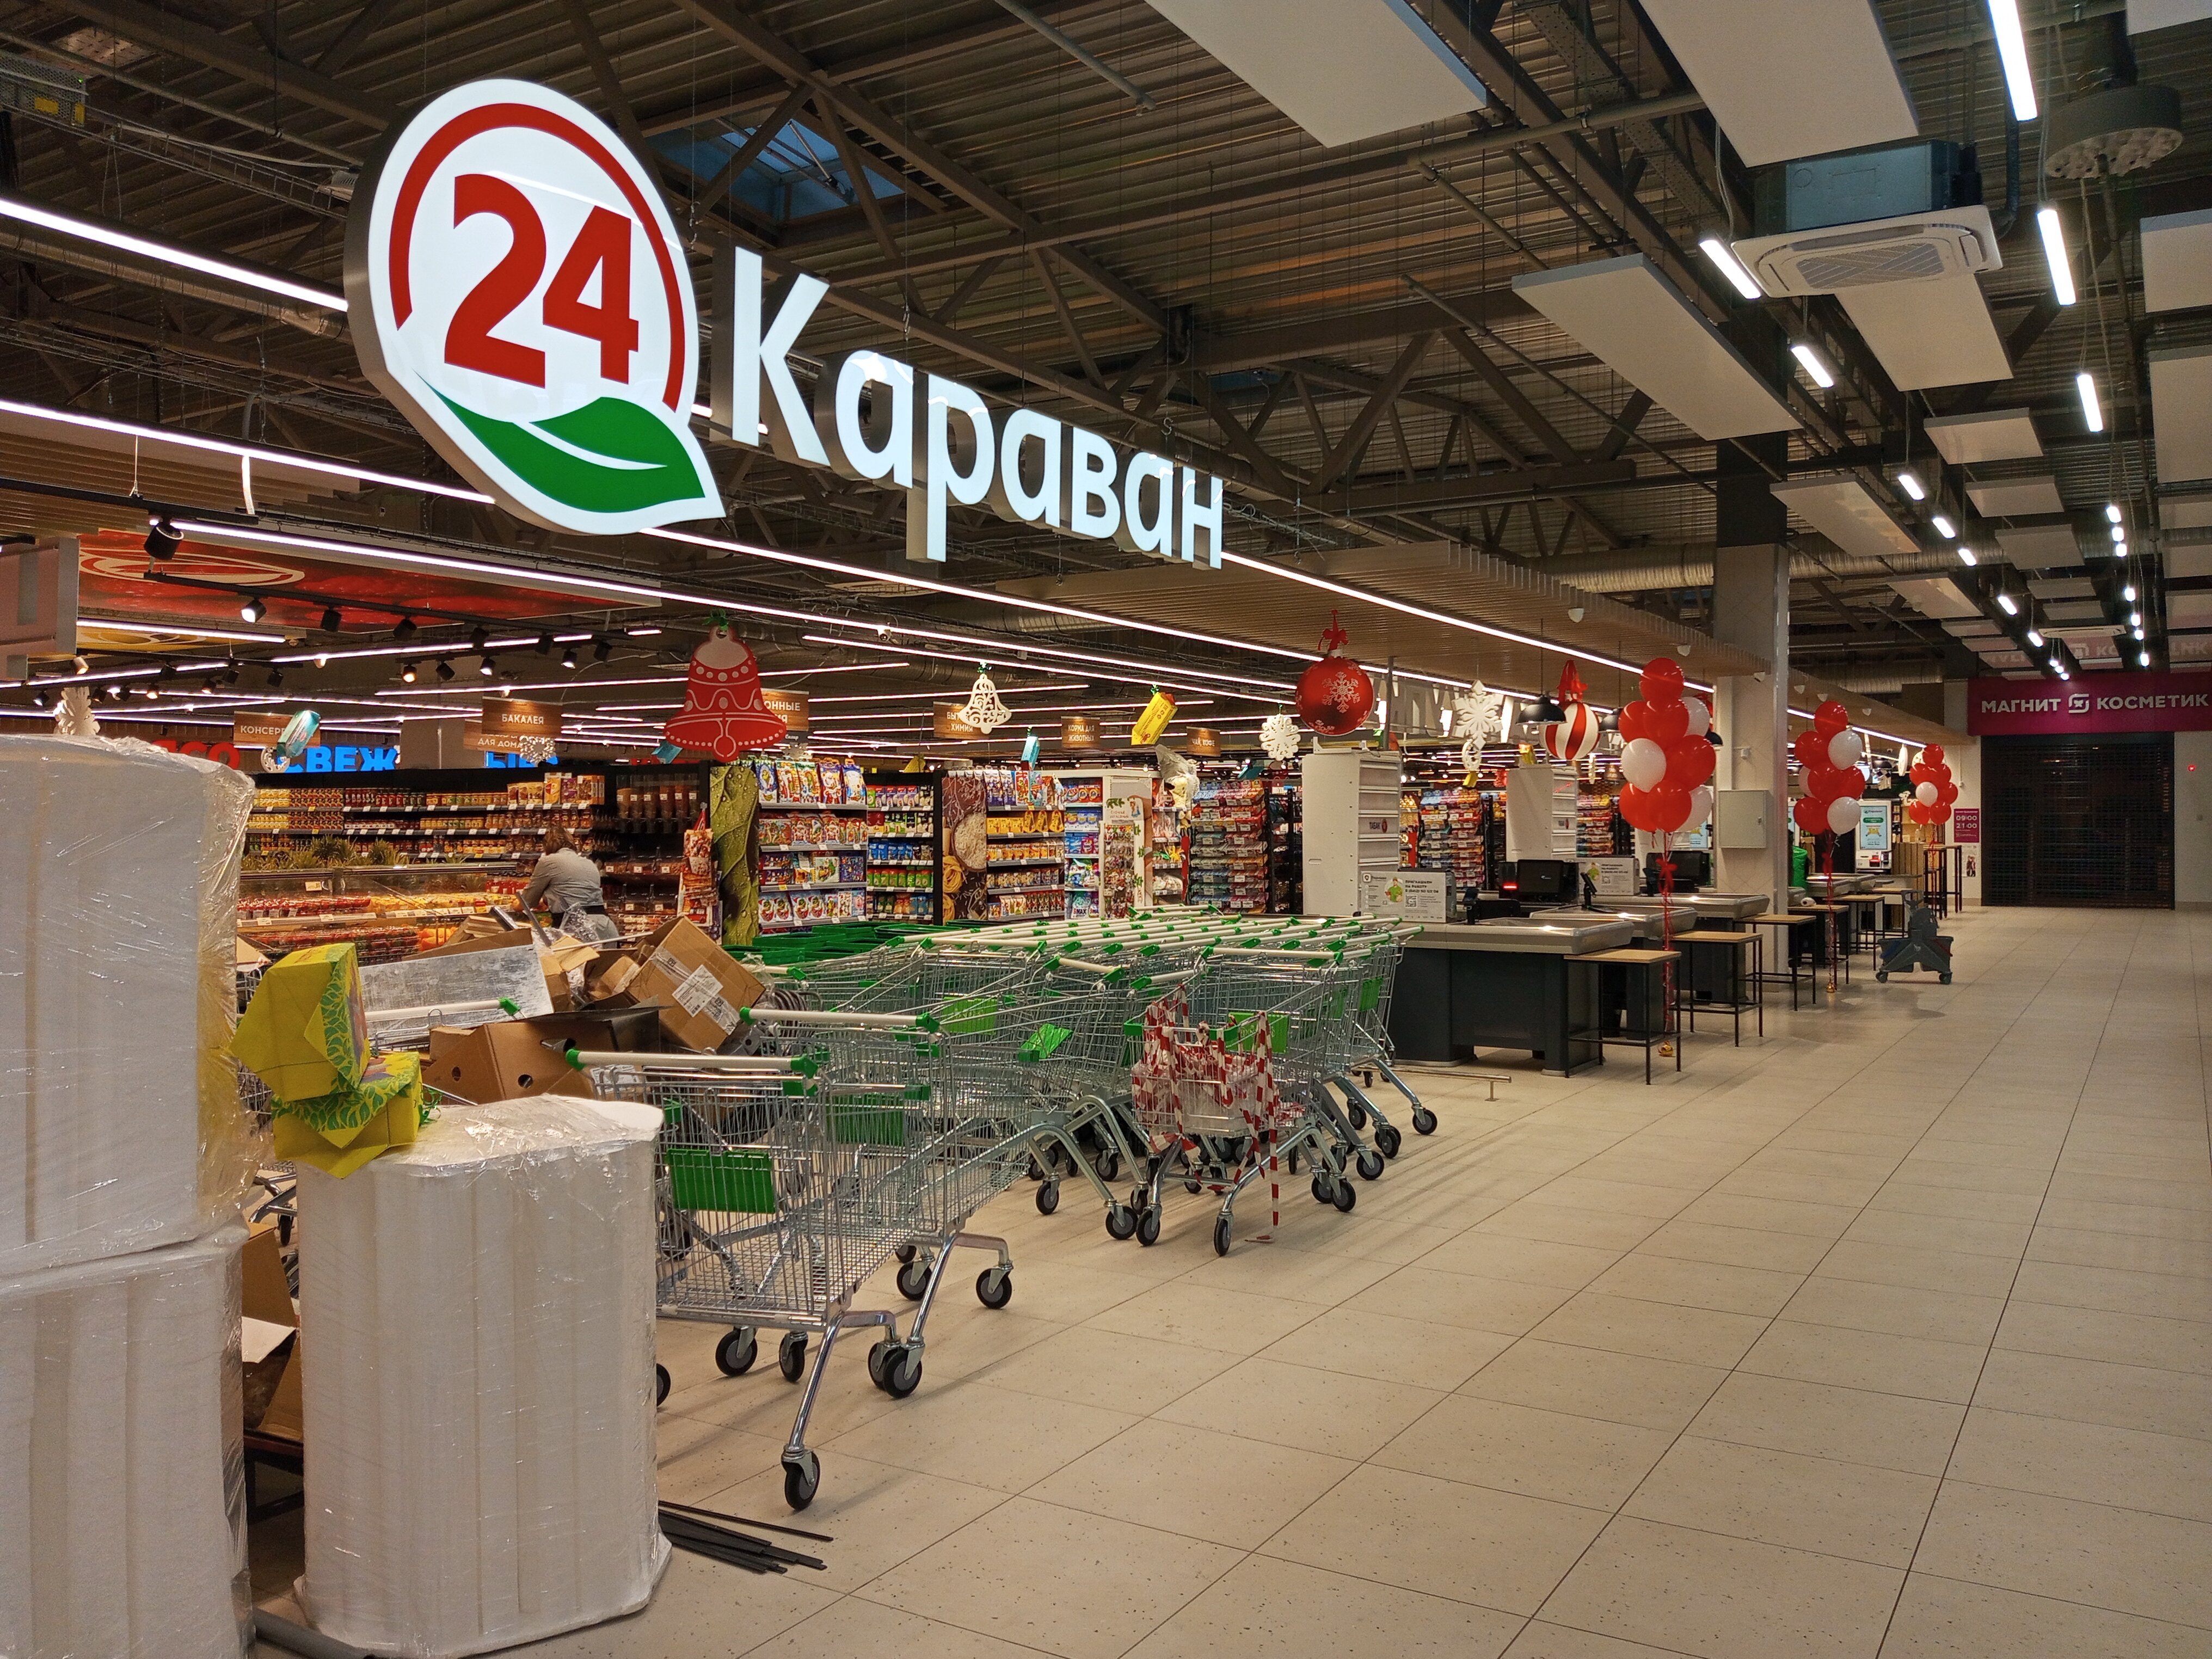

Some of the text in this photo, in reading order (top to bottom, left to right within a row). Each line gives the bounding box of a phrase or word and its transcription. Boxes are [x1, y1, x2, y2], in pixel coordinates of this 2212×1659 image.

[444, 173, 639, 389] 24
[732, 246, 1223, 569] Караван
[764, 701, 801, 711] ОННЫЕ
[1981, 694, 2209, 713] МАГНИТ КОСМЕТИК
[501, 714, 544, 724] БАКАЛЕЯ
